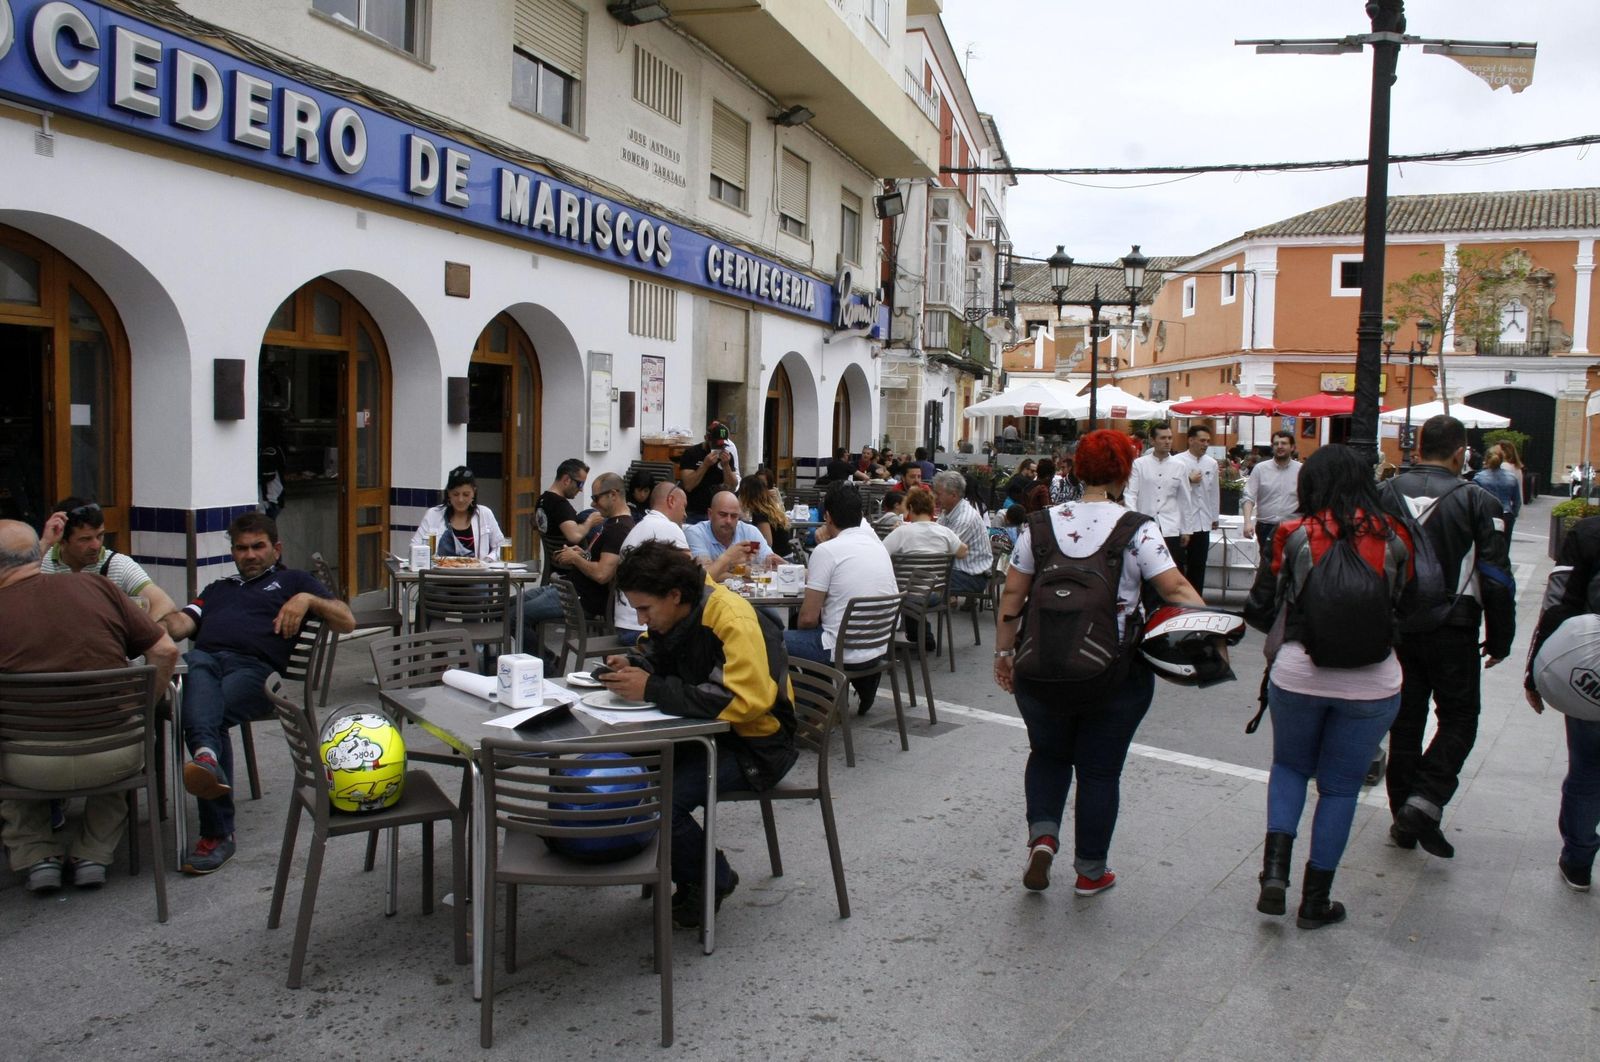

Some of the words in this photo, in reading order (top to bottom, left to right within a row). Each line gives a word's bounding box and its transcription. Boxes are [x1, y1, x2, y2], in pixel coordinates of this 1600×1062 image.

[0, 0, 369, 175] CEDERO
[407, 133, 471, 208] DE
[500, 168, 672, 267] MARISCOS
[707, 244, 815, 311] CERVECERIA
[622, 147, 649, 170] ROMERO
[650, 140, 680, 163] ANTONIO
